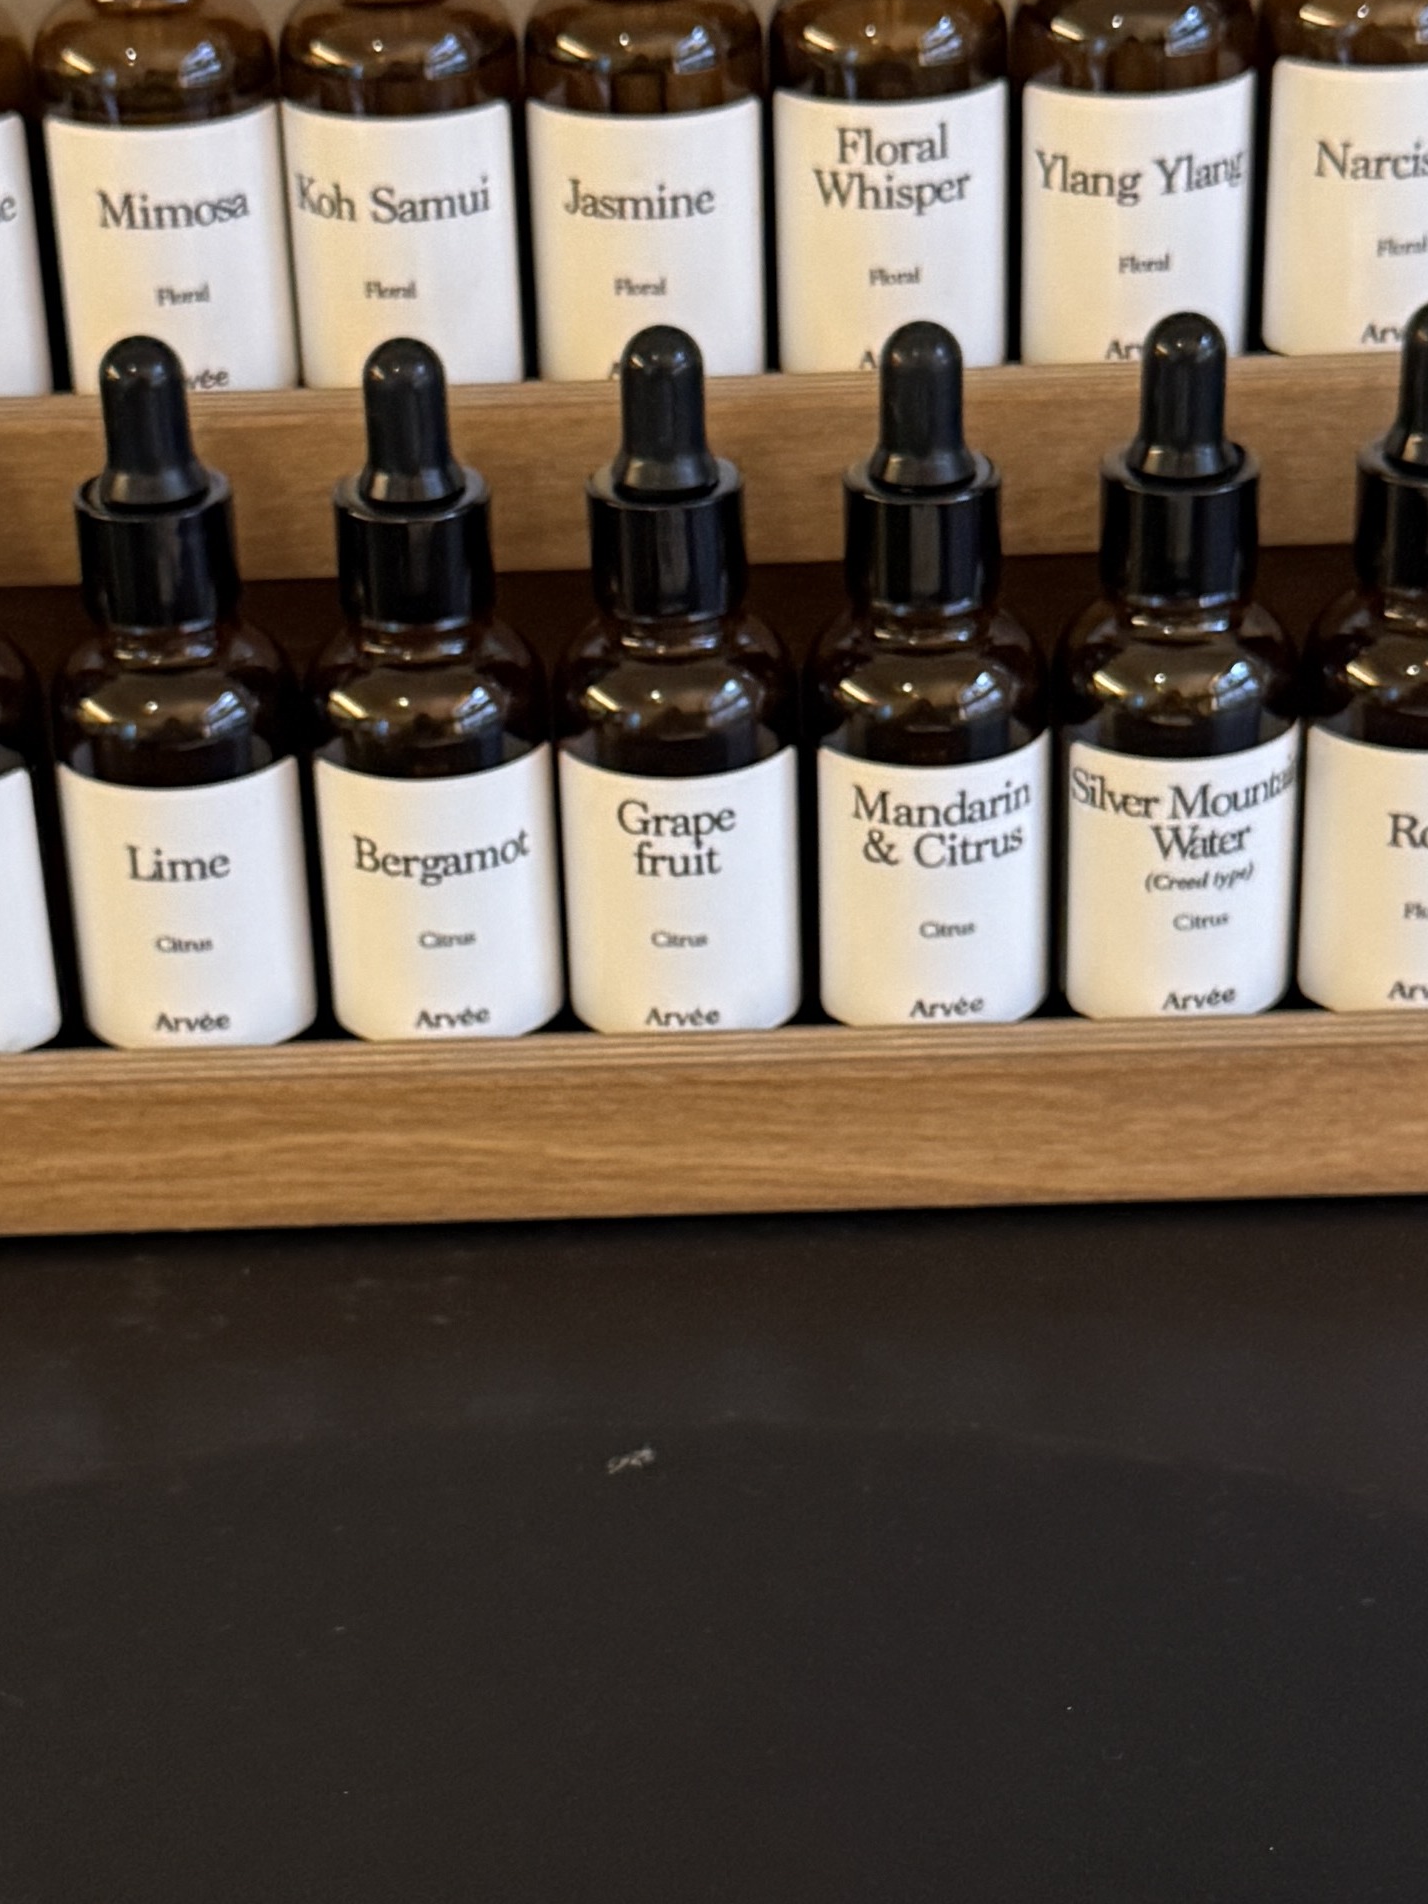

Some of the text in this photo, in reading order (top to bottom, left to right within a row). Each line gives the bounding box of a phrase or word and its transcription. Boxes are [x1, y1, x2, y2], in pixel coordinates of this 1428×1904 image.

[835, 123, 948, 166] Floral
[813, 168, 972, 216] Whisper
[1034, 148, 1243, 206] Ylang Ylang
[98, 187, 249, 230] Mimosa
[294, 174, 492, 224] Koh Samui
[564, 177, 716, 220] Jasmine
[1361, 323, 1404, 345] Arv
[185, 365, 230, 390] vée
[852, 781, 1030, 829] Mandarin
[1072, 766, 1159, 817] Silver
[615, 799, 736, 844] Grape
[352, 829, 530, 887] Bergamot
[632, 842, 720, 877] fruit
[863, 824, 1024, 869] & Citrus
[1150, 824, 1251, 860] Water
[125, 845, 230, 883] Lime
[1145, 861, 1254, 893] (Creed type)
[919, 921, 976, 939] Citrus
[1173, 911, 1230, 931] Citrus
[155, 934, 212, 953] Citrus
[419, 931, 476, 949] Citrus
[650, 930, 708, 949] Citrus
[645, 1005, 720, 1029] Arvée
[909, 995, 984, 1019] Arvée
[1162, 987, 1236, 1012] Arvée
[155, 1010, 230, 1033] Arvée
[414, 1005, 490, 1030] Arvée
